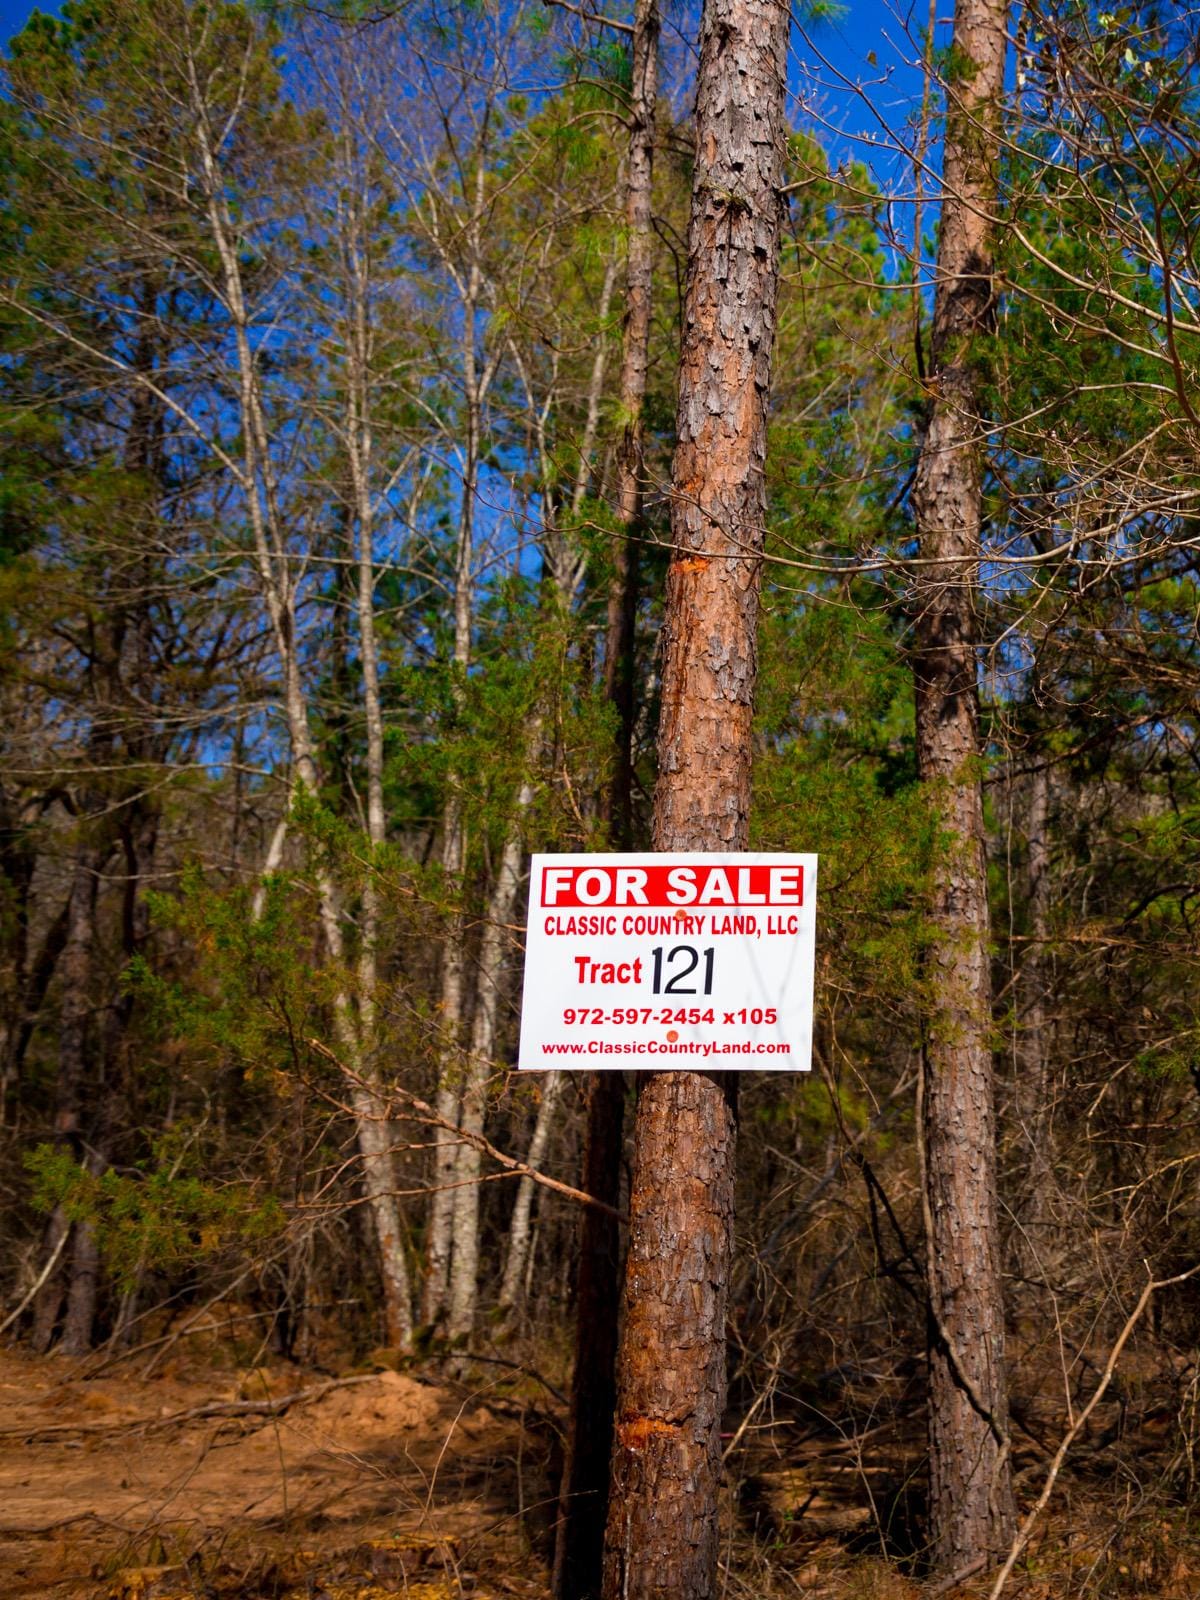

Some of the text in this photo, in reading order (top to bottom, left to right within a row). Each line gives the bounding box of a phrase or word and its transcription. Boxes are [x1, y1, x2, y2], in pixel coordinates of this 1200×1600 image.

[544, 867, 800, 905] FOR SALE
[544, 915, 798, 939] CLASSIC COUNTRY LAND, LLC
[574, 945, 715, 995] Tract 121
[563, 1008, 777, 1025] 972-597-2454 x105
[542, 1040, 790, 1057] www.ClassicCountryLand.com
